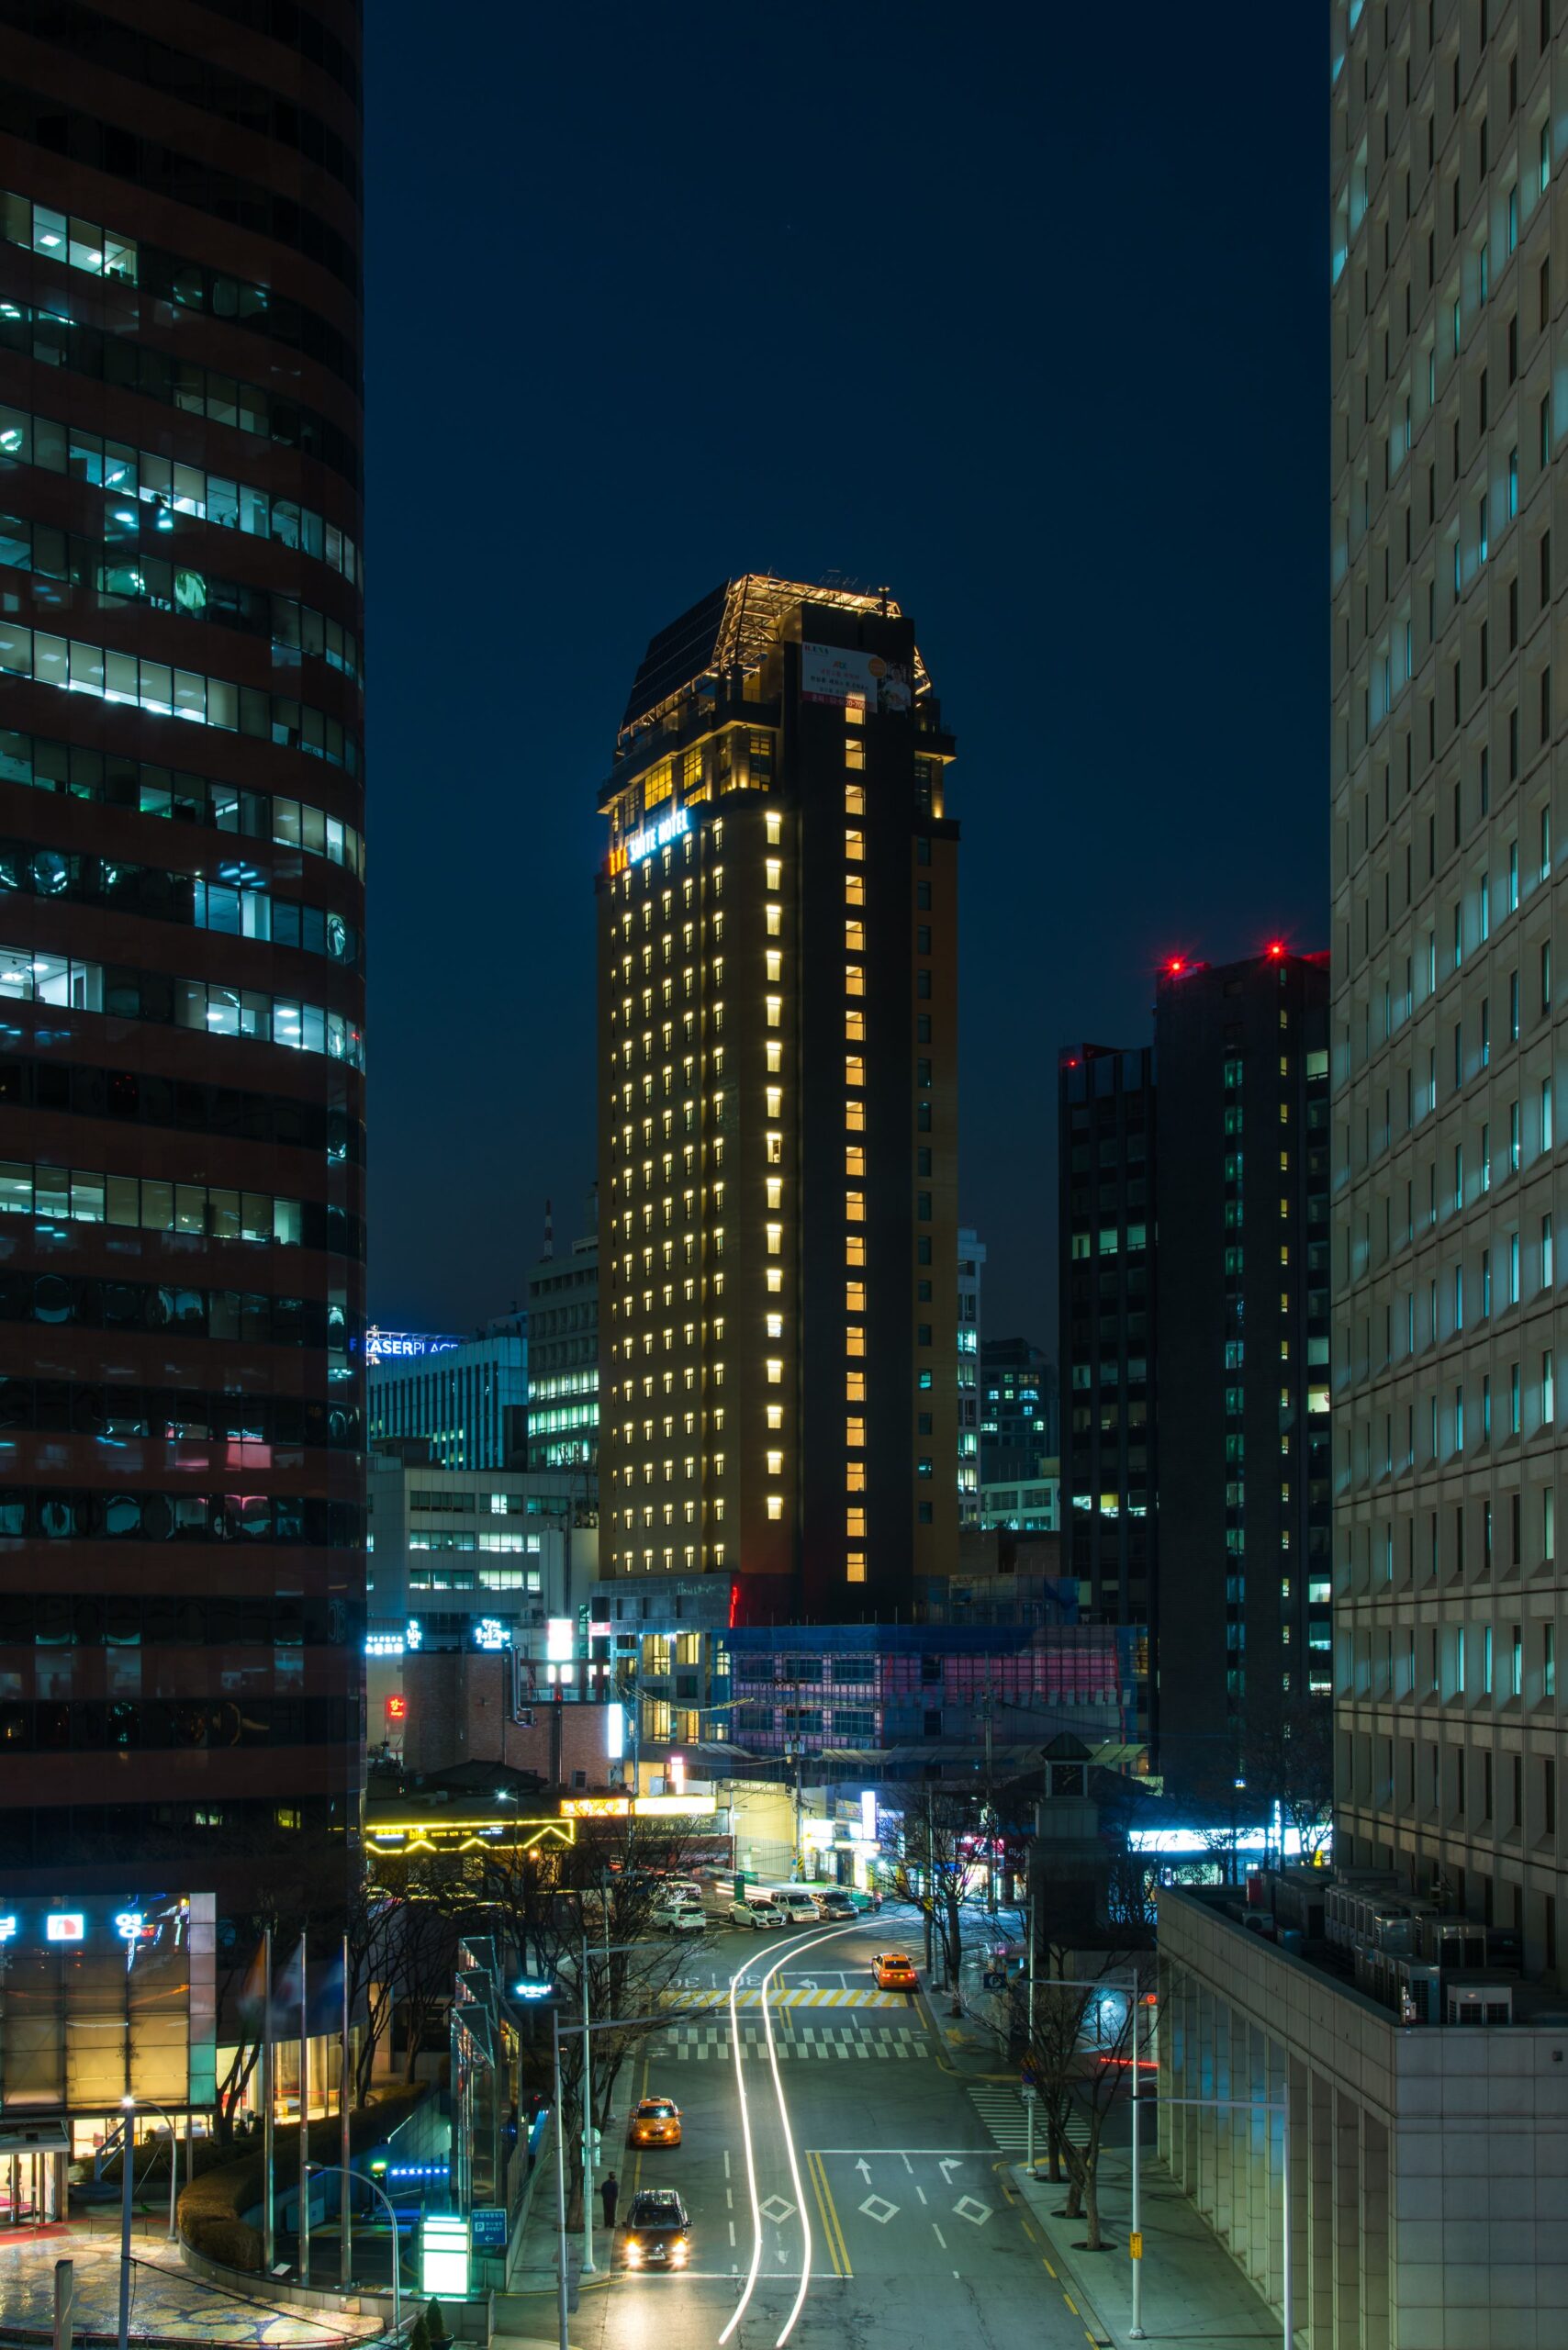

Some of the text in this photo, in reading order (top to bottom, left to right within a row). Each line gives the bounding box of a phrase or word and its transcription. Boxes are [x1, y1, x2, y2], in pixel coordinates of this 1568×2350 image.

[630, 828, 656, 863] SUITE
[658, 809, 689, 845] HOTEL
[409, 1830, 427, 1840] bhc
[115, 1913, 142, 1938] 영
